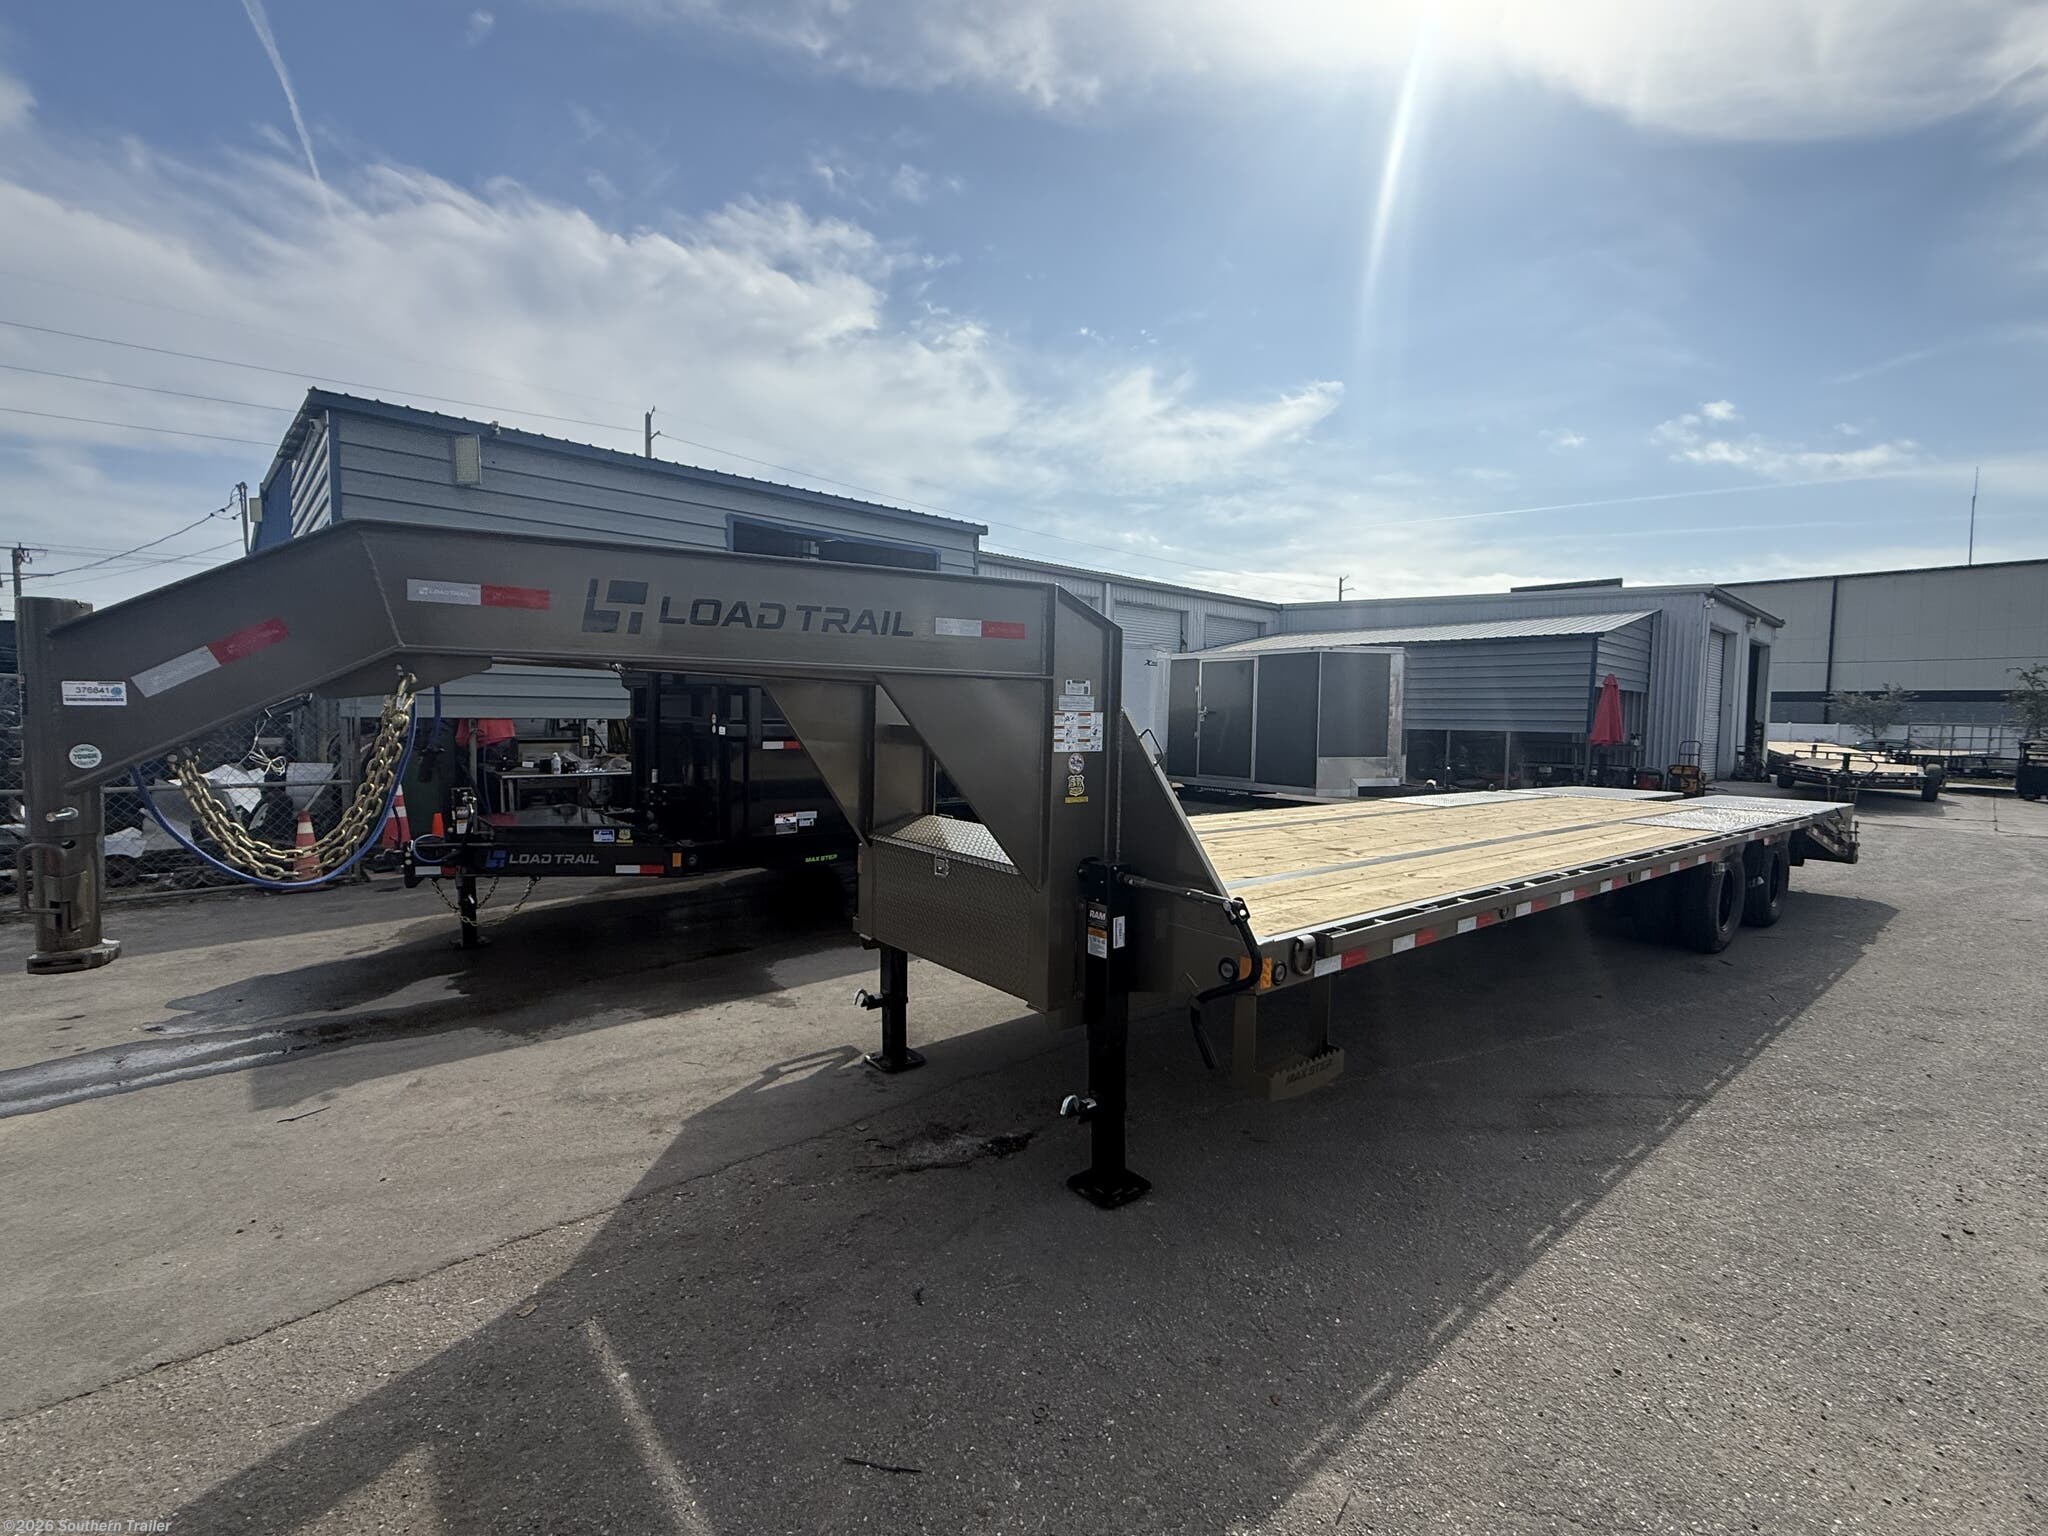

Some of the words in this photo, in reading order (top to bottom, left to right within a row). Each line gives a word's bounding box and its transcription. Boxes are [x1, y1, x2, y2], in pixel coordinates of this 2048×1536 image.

[658, 596, 786, 630] LOAD
[796, 604, 914, 637] TRAIL
[509, 854, 552, 864] LOAD
[554, 854, 599, 864] TRAIL
[1089, 910, 1106, 921] RAM
